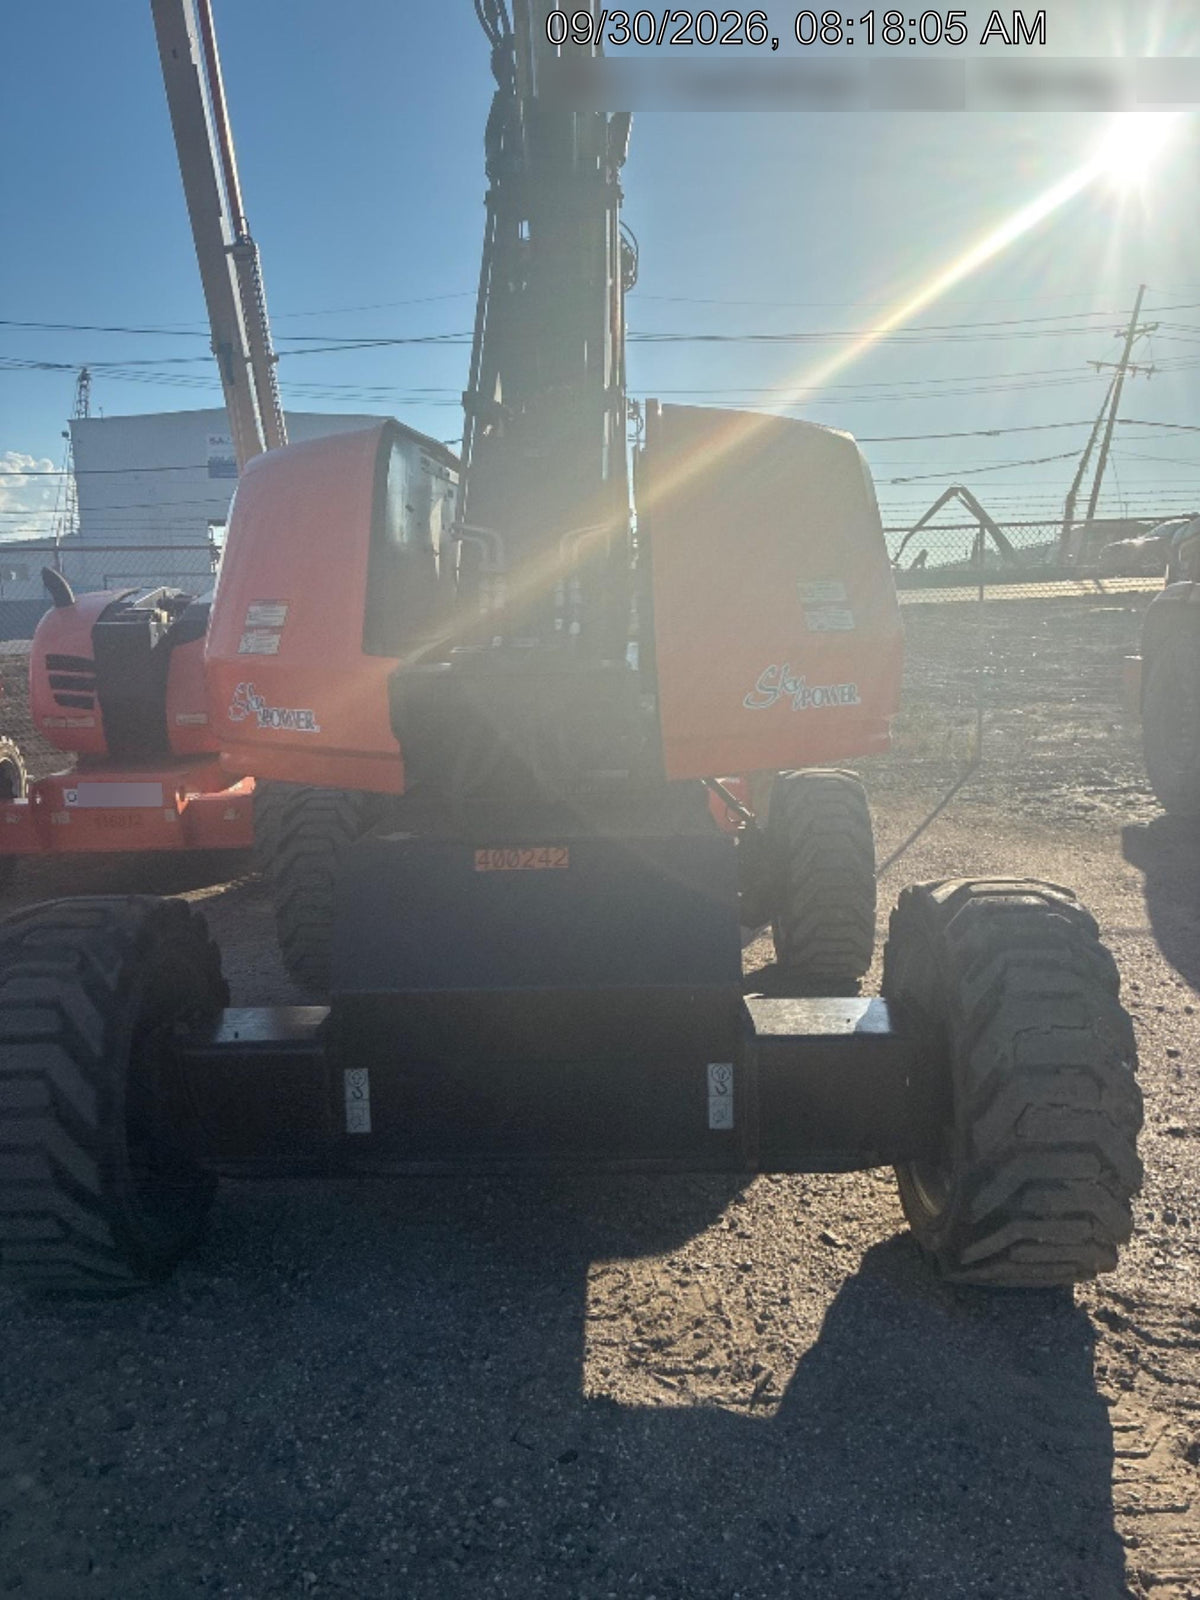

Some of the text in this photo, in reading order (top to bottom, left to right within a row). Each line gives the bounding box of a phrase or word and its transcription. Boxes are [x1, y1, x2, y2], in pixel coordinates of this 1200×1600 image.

[800, 682, 861, 708] POWER
[258, 707, 320, 732] POWER
[475, 848, 568, 870] 400242
